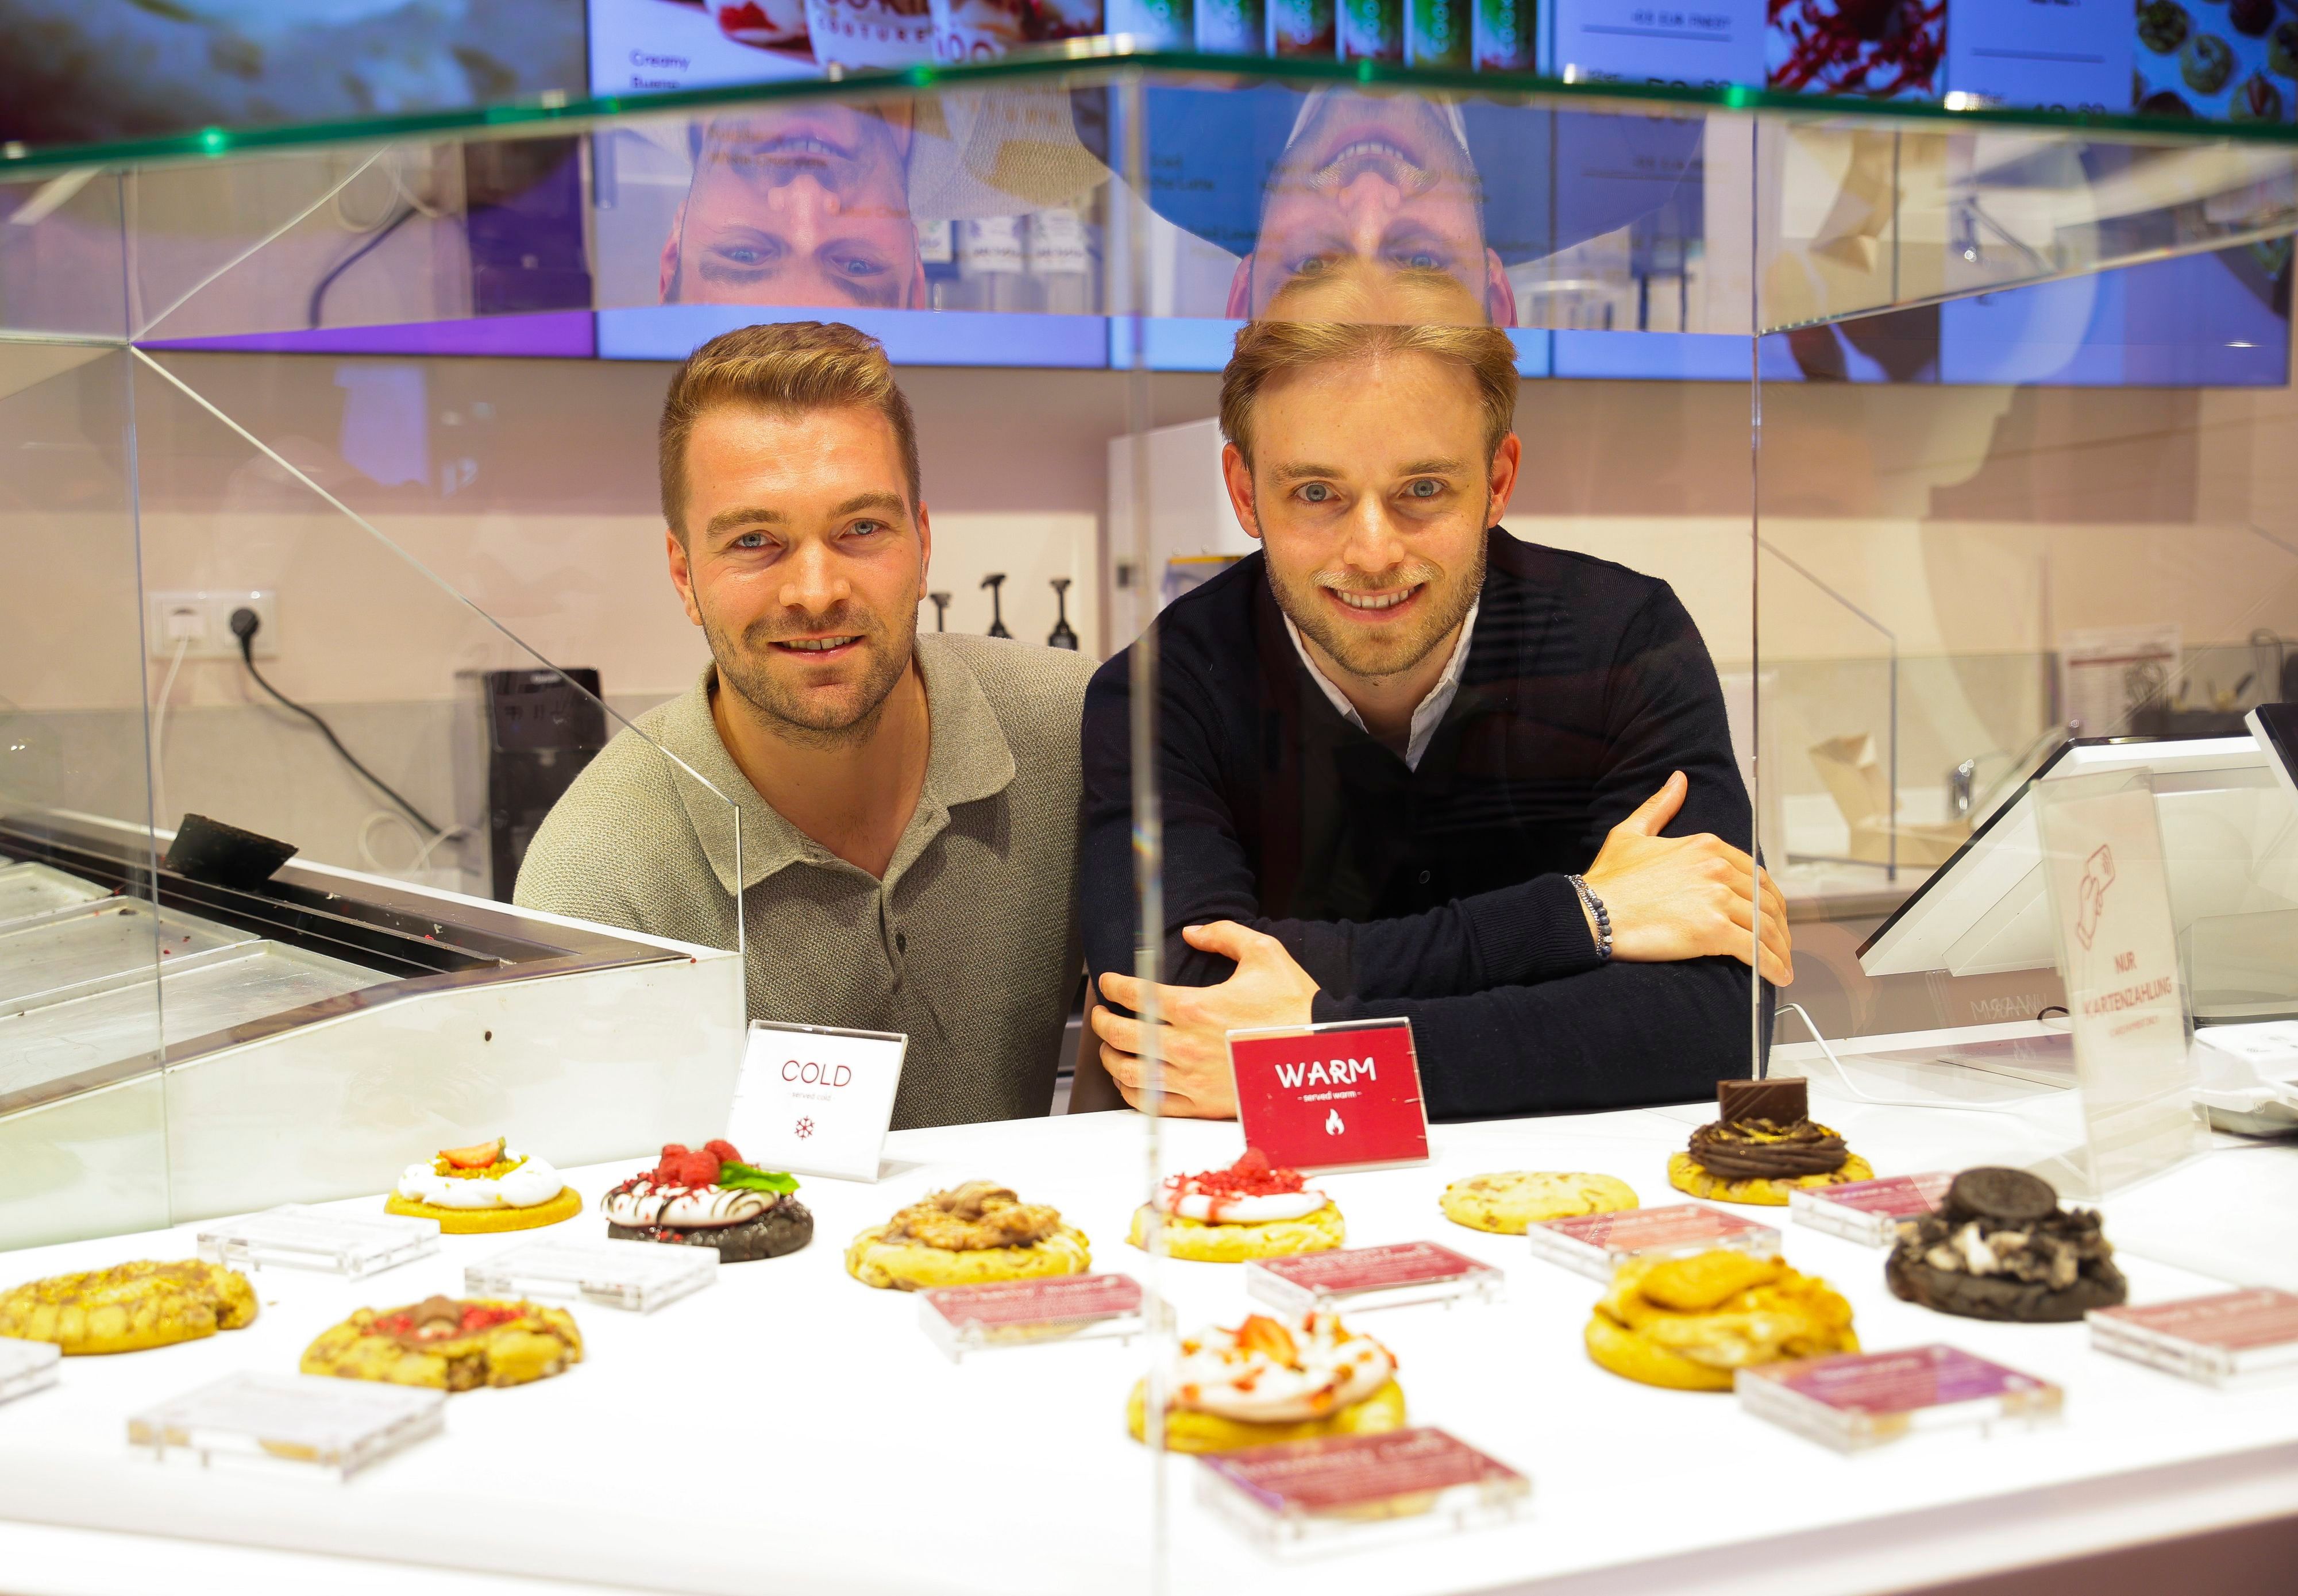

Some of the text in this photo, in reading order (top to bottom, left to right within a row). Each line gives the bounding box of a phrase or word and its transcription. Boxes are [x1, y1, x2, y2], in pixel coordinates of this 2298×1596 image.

[629, 48, 691, 72] Creamy
[2115, 951, 2137, 974] NUR
[2083, 977, 2172, 1016] KARTENZAHLUNG
[782, 1060, 851, 1087] COLD
[1275, 1057, 1377, 1089] WARM
[1303, 1090, 1358, 1102] served warm
